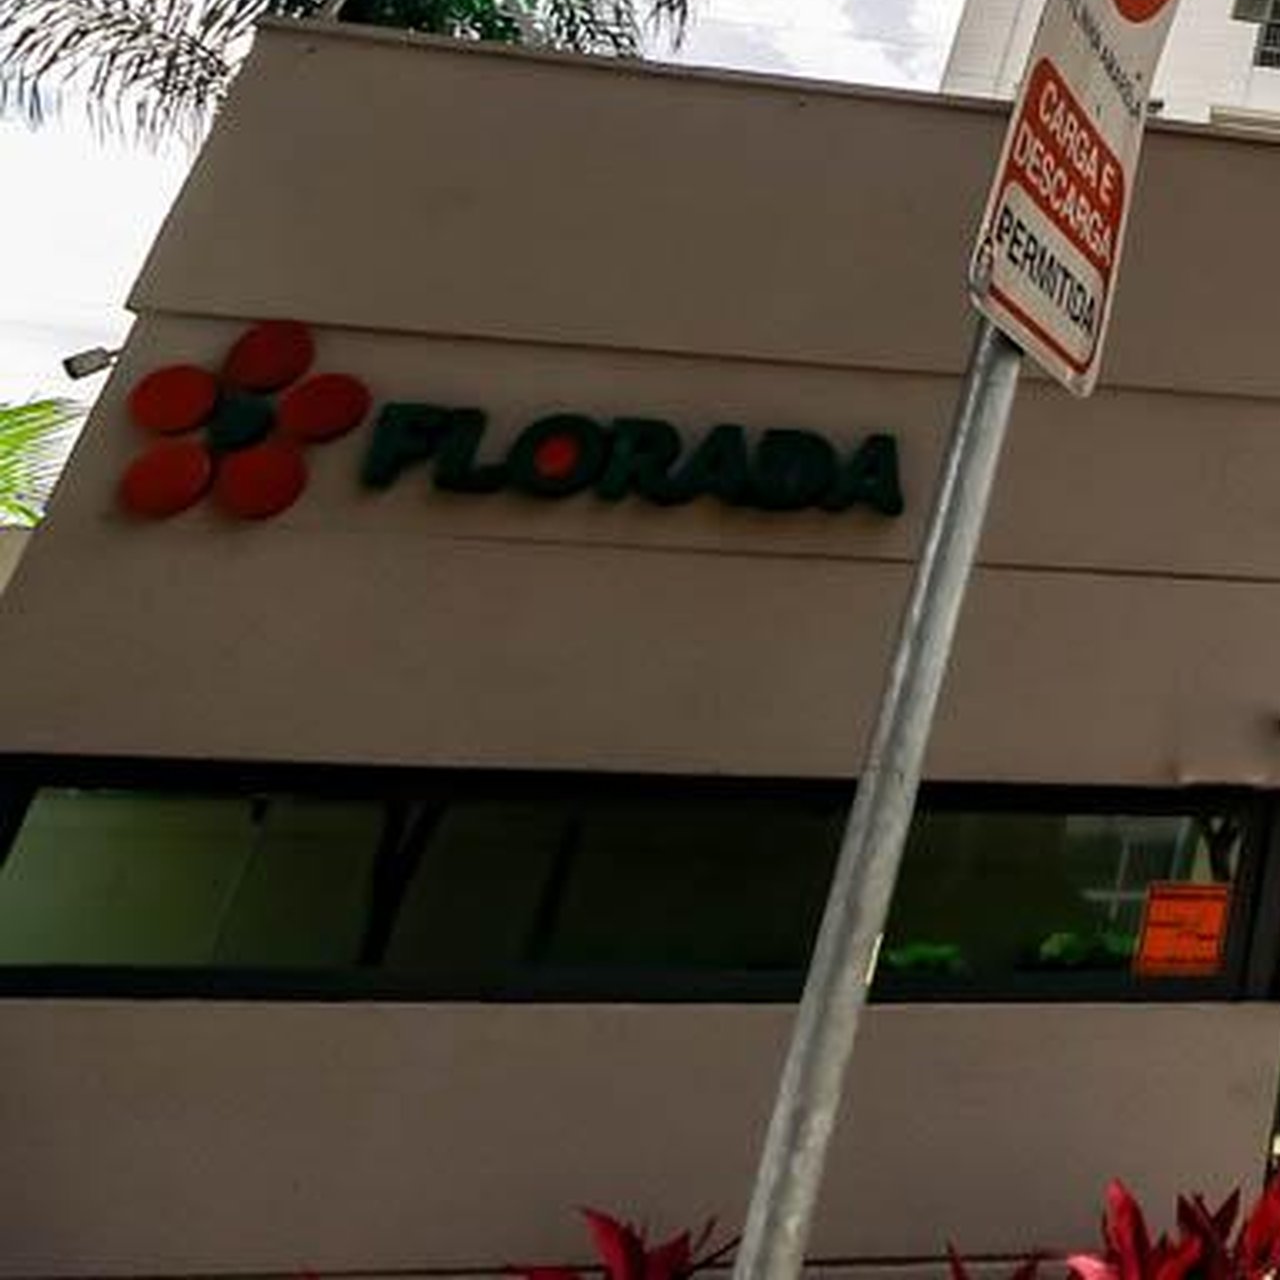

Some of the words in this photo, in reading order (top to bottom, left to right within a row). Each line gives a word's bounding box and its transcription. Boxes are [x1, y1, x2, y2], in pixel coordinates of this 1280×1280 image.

[1012, 121, 1112, 267] DESCARGA
[1039, 80, 1099, 188] CARGA
[1099, 163, 1114, 205] E
[996, 205, 1097, 335] PERMITIDA
[362, 402, 904, 516] FLORADA
